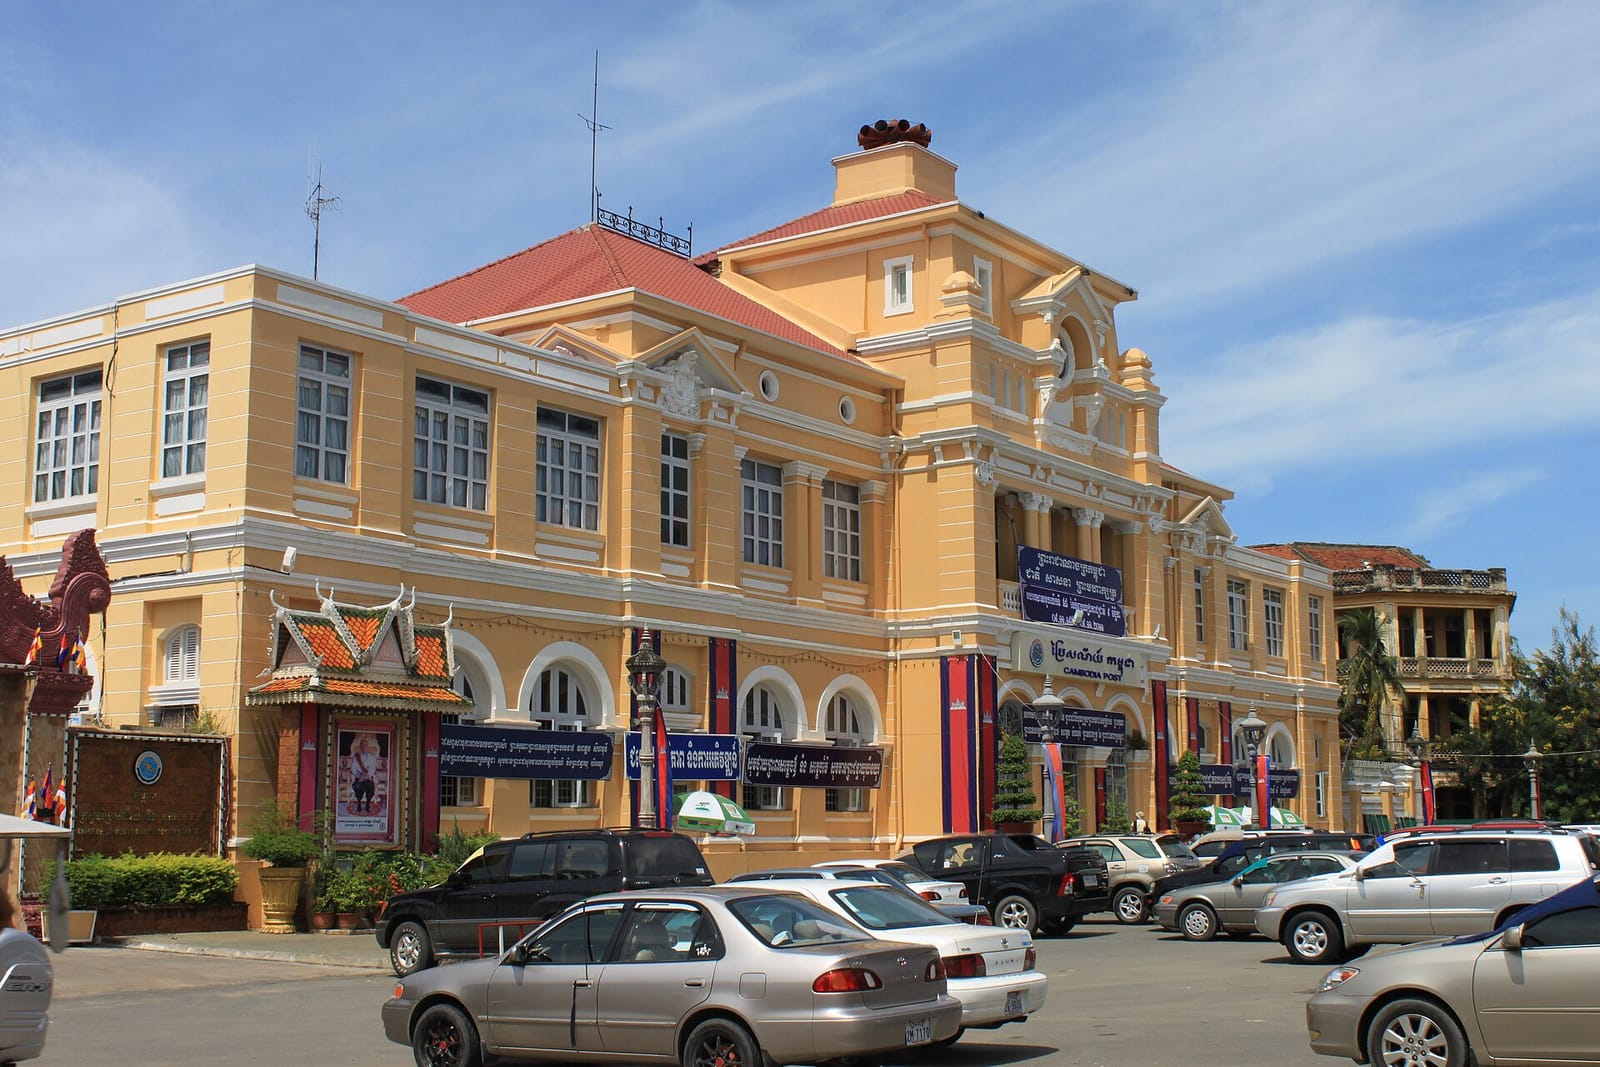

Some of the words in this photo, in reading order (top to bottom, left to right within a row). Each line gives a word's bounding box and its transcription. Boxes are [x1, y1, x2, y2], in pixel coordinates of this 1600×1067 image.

[1025, 566, 1041, 582] ជាតិ
[1045, 573, 1072, 588] សាសនា
[1063, 666, 1102, 680] CAMBODIA
[1103, 672, 1122, 683] POST
